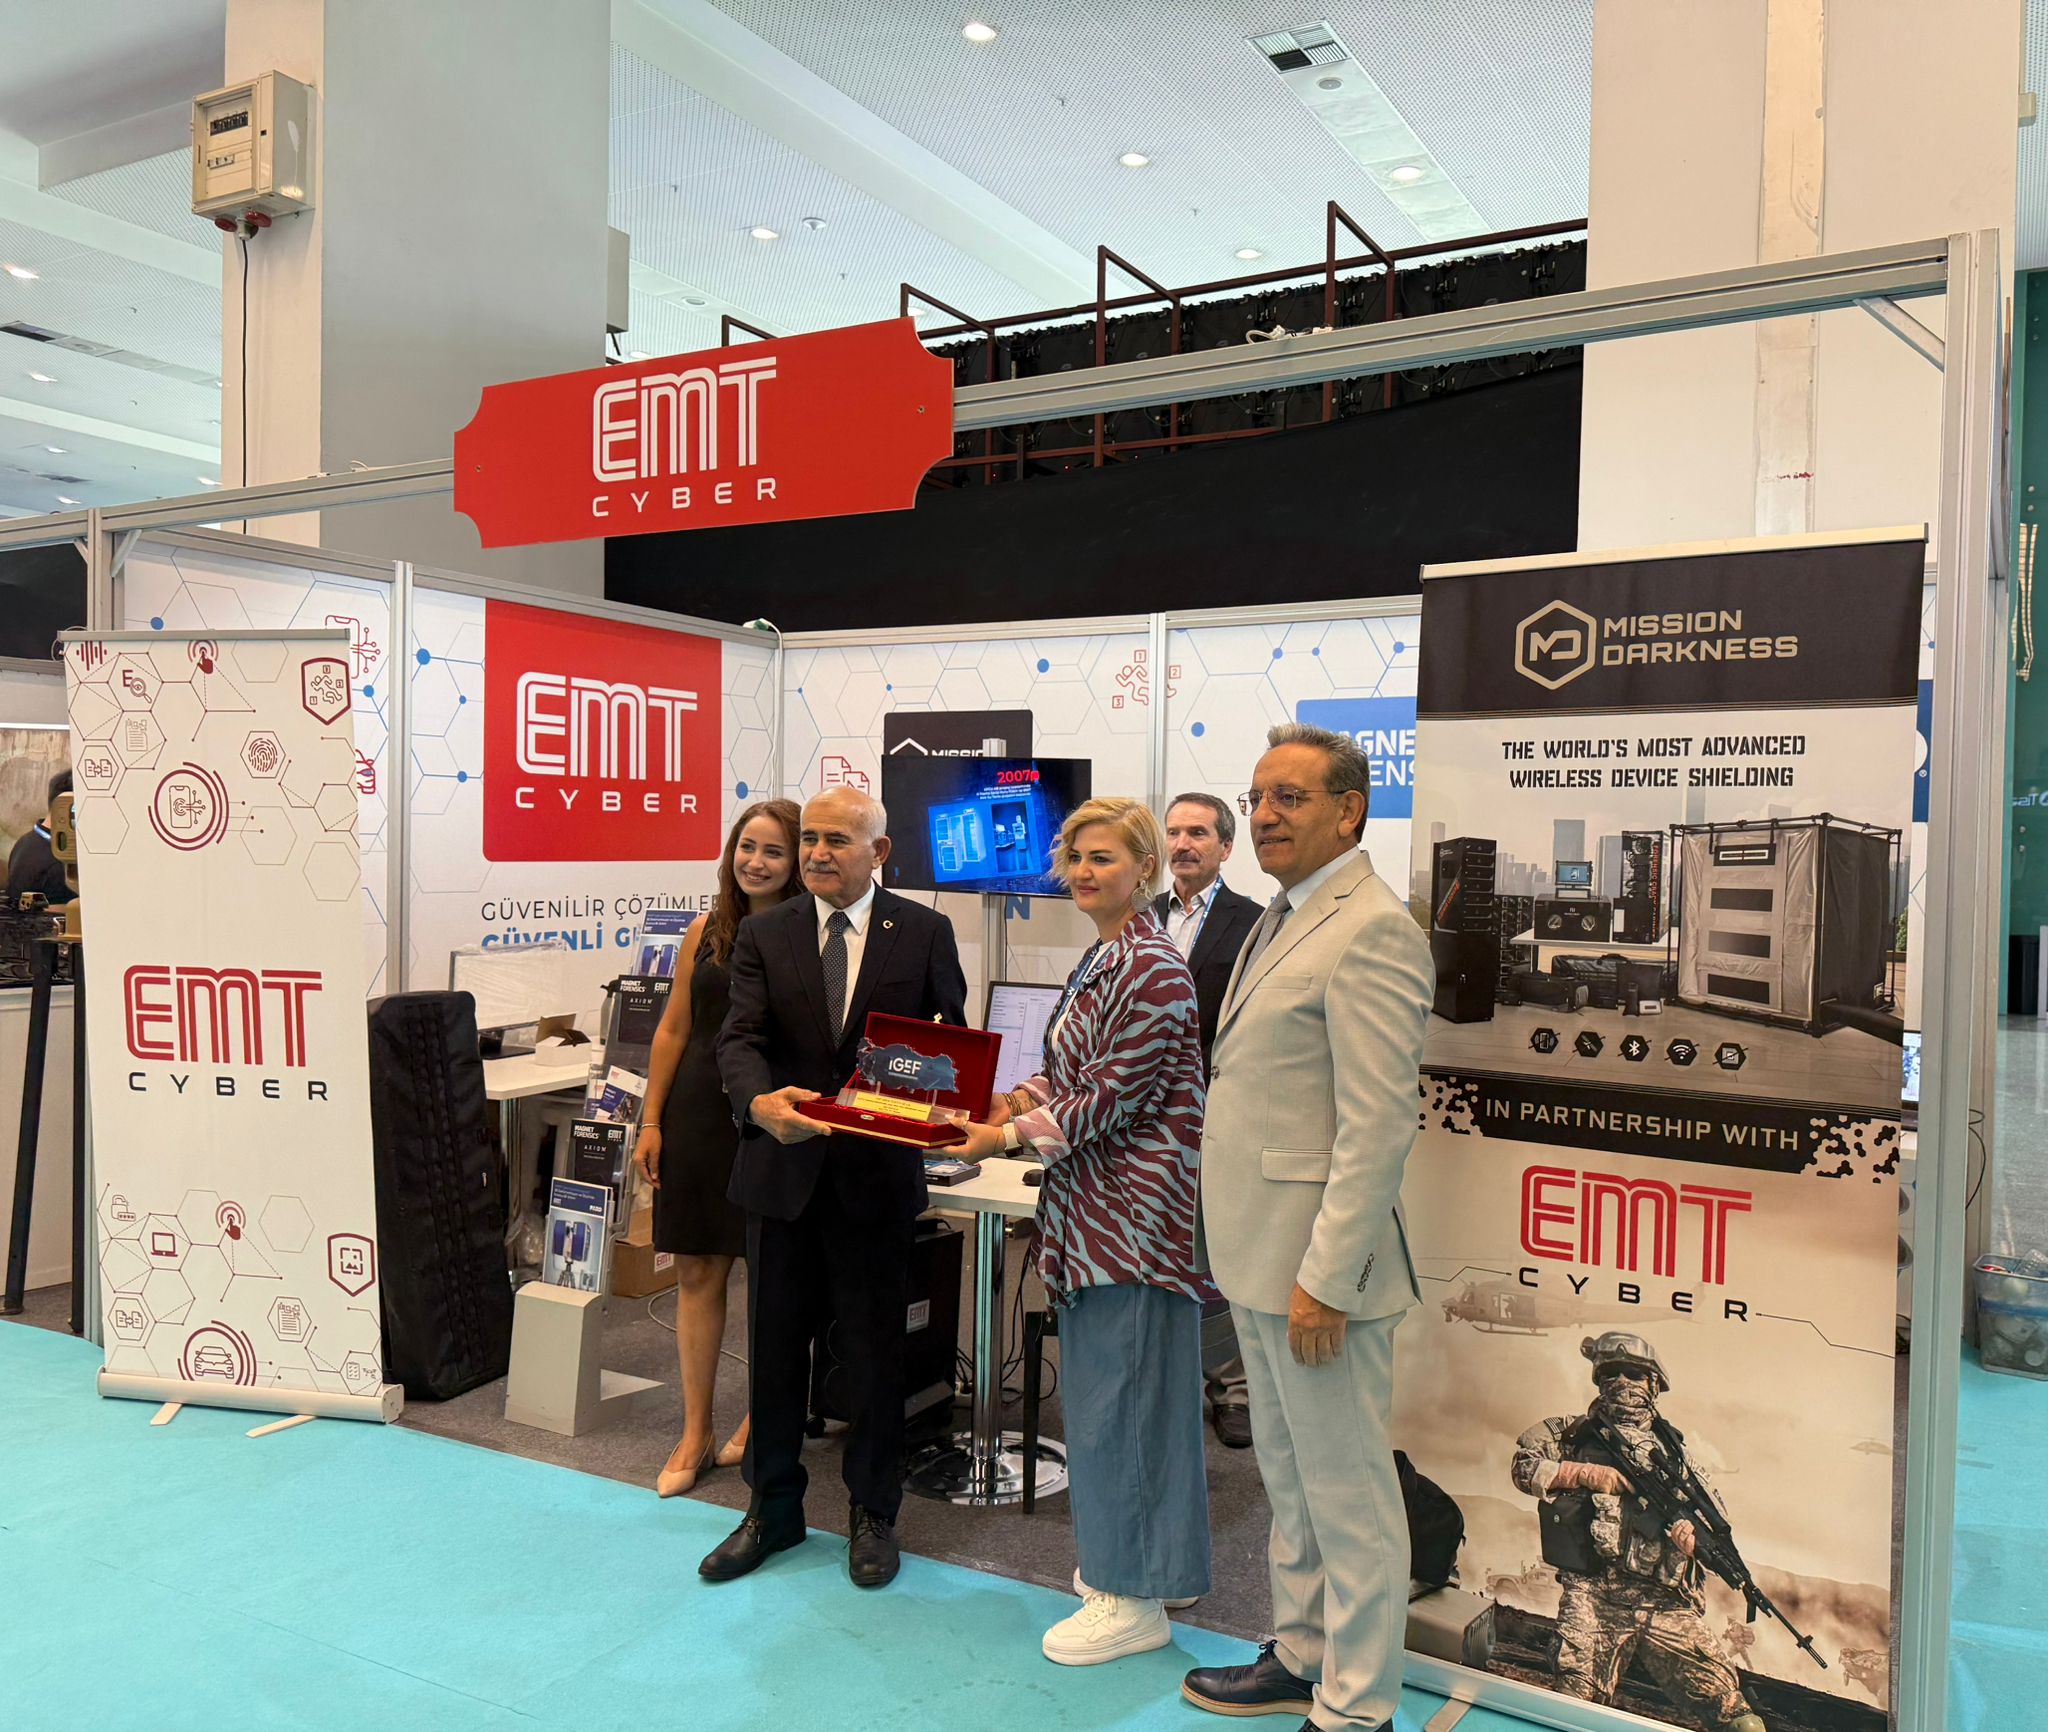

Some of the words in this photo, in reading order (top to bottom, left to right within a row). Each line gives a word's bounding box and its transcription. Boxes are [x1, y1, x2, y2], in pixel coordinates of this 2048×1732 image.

[593, 356, 777, 483] EMT
[592, 477, 777, 517] CYBER
[1603, 609, 1742, 638] MISSION
[1602, 635, 1798, 666] DARKNESS
[516, 671, 698, 782] EMT
[1501, 741, 1535, 760] THE
[1543, 738, 1628, 759] WORLD'S
[1636, 737, 1693, 758] MOST
[1701, 735, 1806, 757] ADVANCED
[1509, 768, 1602, 789] WIRELESS
[1611, 768, 1679, 788] DEVICE
[1688, 766, 1794, 788] SHIELDING
[515, 786, 698, 814] CYBER
[481, 895, 605, 921] GÜVENİLİR
[124, 965, 323, 1068] EMT
[128, 1072, 329, 1101] CYBER
[1486, 1098, 1510, 1119] IN
[1520, 1102, 1712, 1140] PARTNERSHIP
[1722, 1123, 1798, 1151] WITH
[1520, 1164, 1752, 1285] EMT
[1518, 1266, 1749, 1322] CYBER
